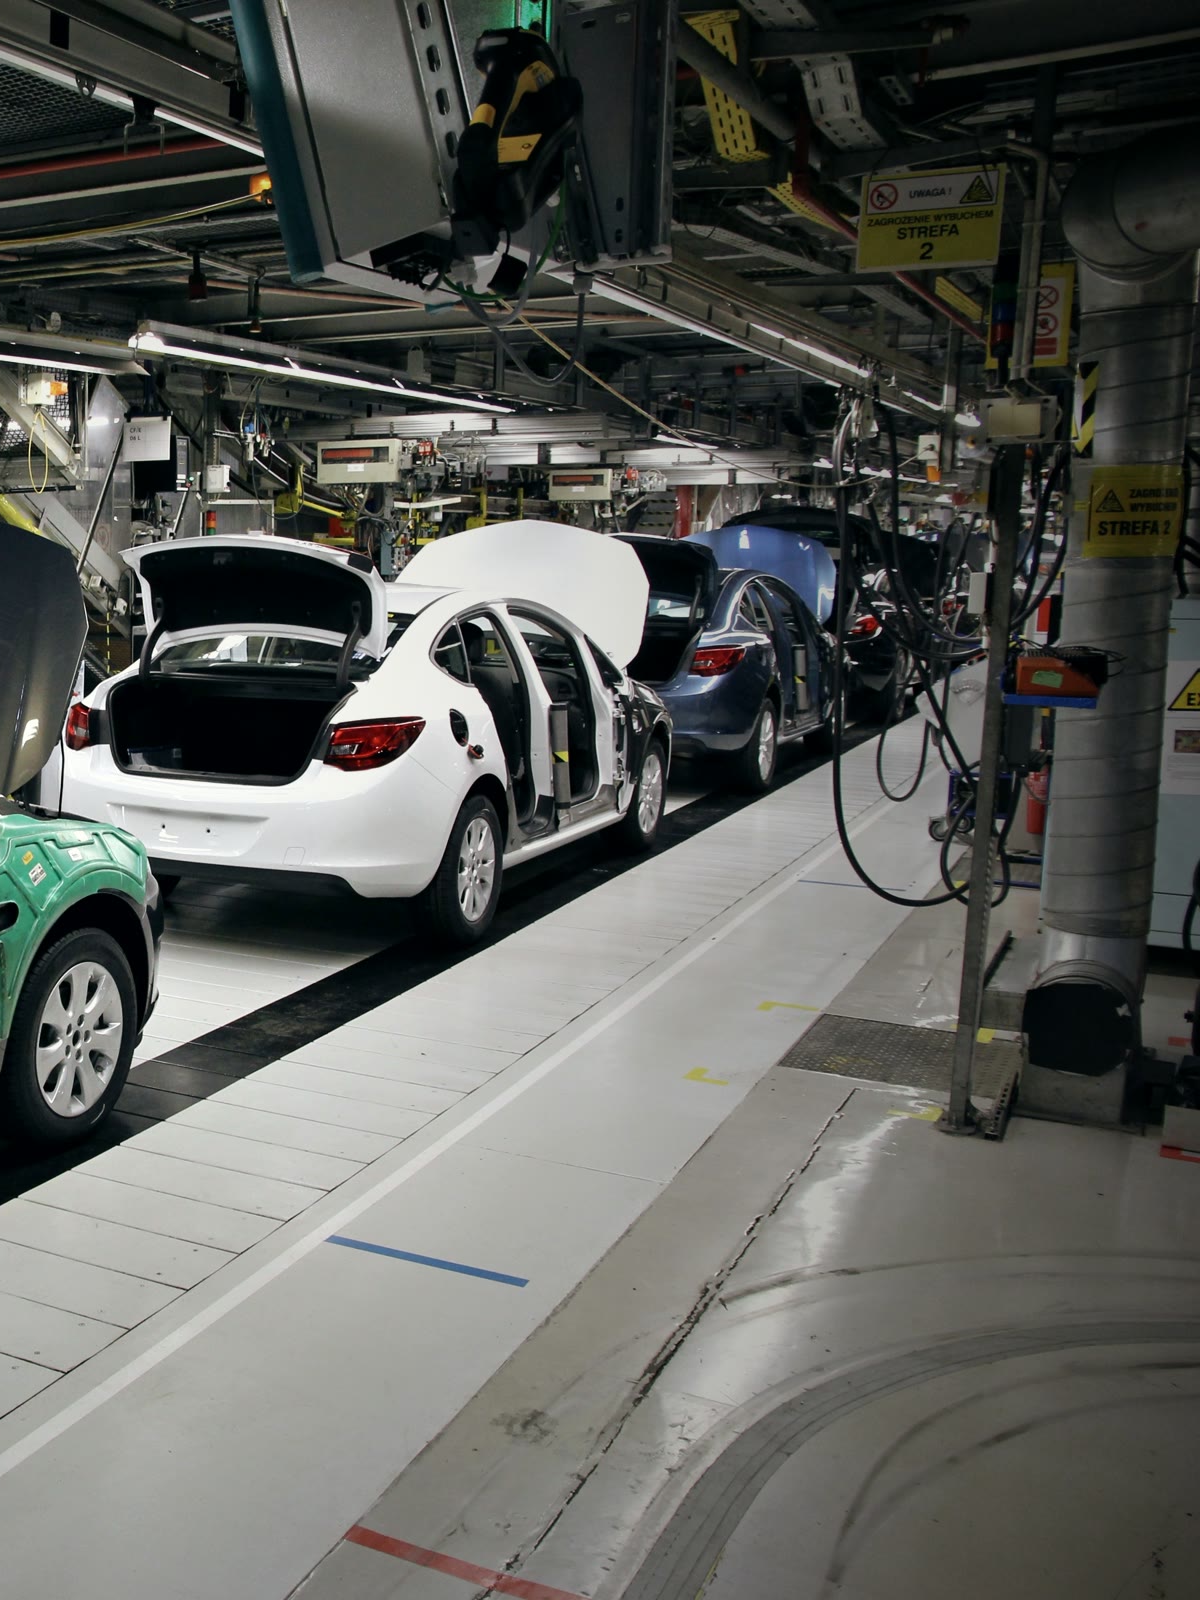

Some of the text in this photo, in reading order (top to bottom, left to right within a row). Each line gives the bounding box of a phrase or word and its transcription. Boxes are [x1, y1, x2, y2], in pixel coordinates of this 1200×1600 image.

[909, 189, 947, 199] UWAGA
[934, 210, 995, 222] WYBUCHEM
[897, 224, 960, 240] STREFA
[919, 242, 934, 260] 2
[1098, 520, 1171, 536] STREFA 2
